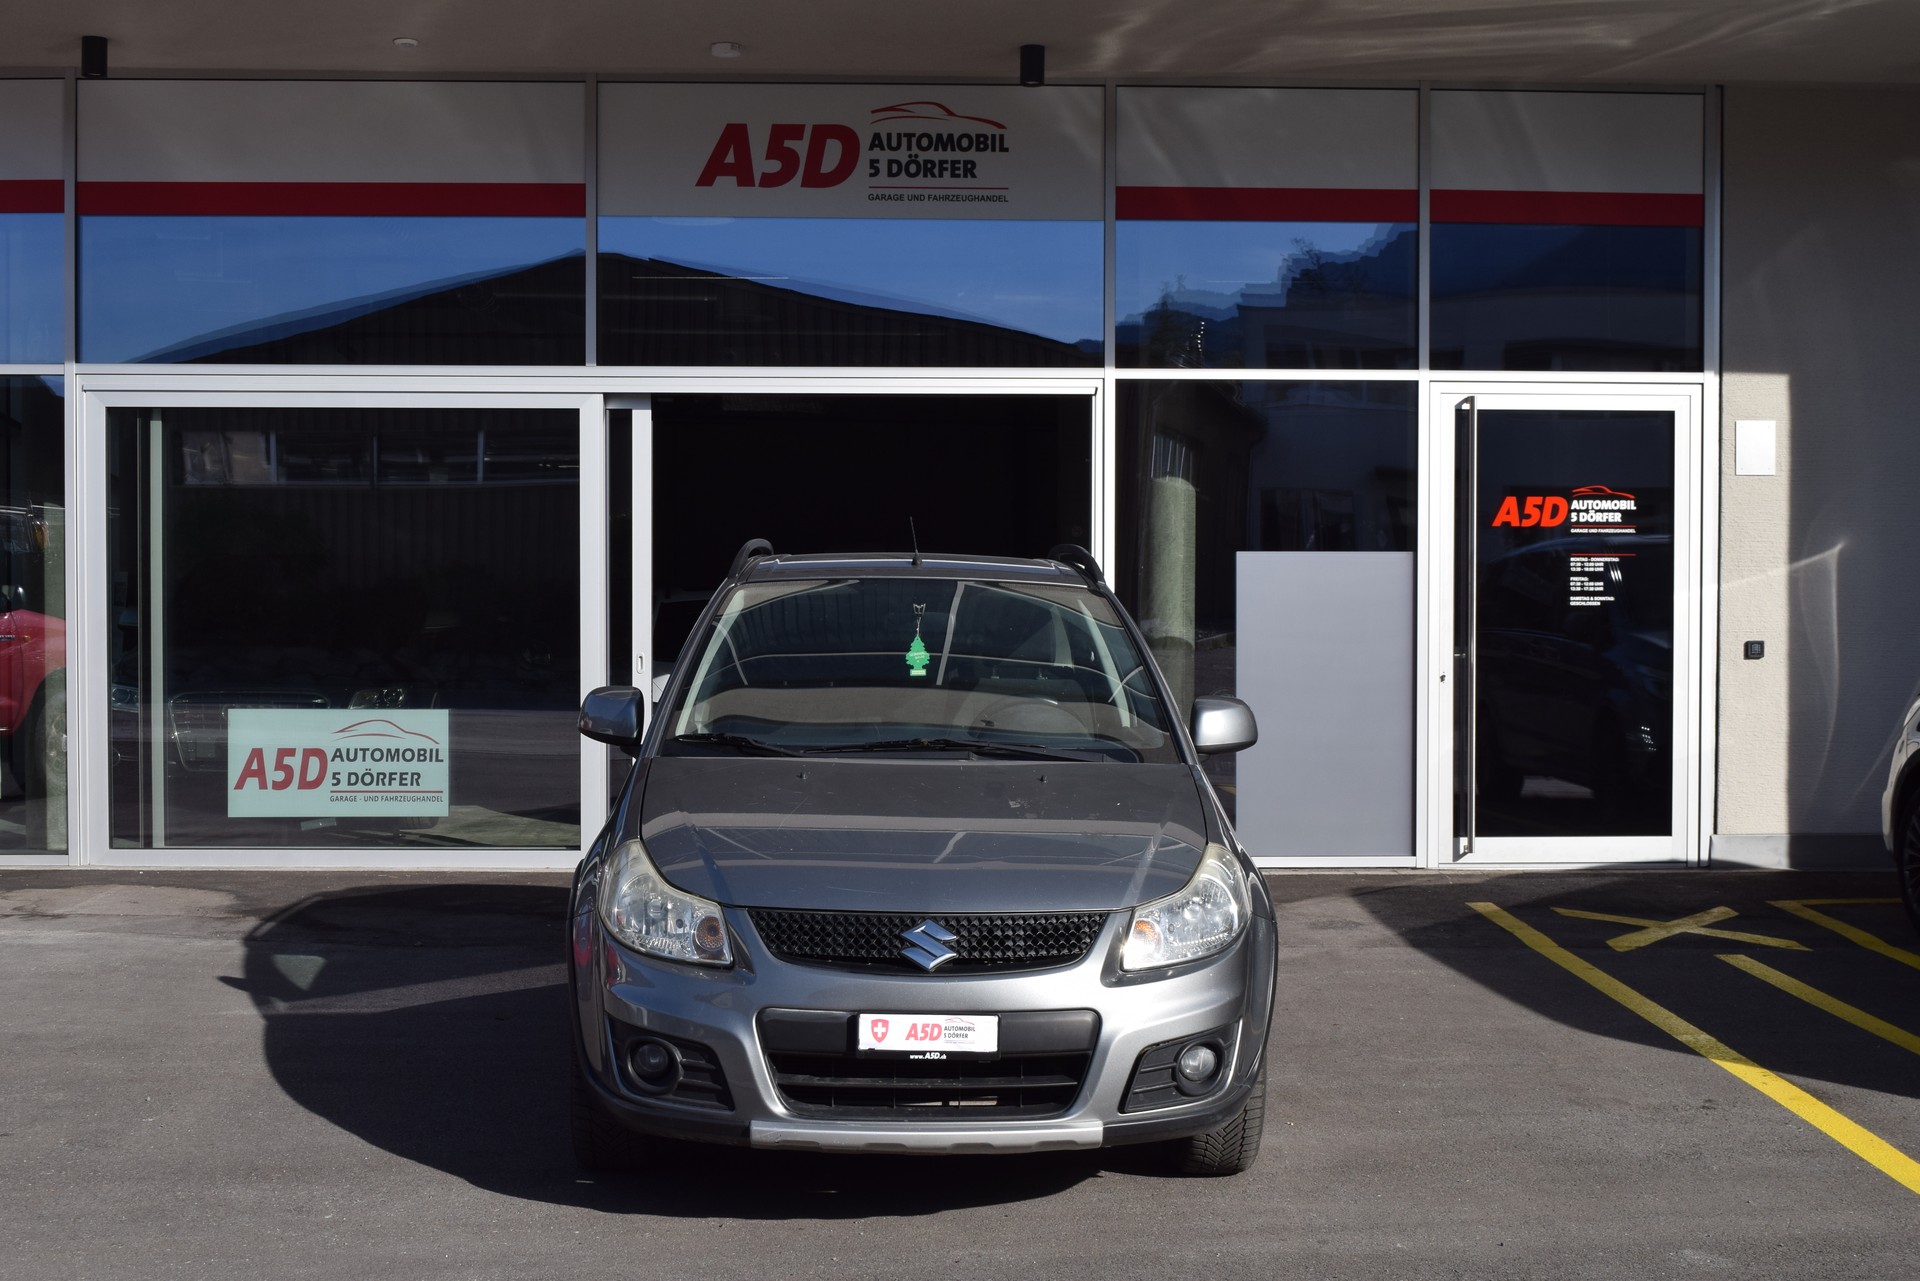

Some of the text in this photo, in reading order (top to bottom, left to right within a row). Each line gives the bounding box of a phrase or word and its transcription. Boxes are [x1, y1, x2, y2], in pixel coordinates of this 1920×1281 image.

[868, 132, 1009, 153] AUTOMOBIL
[695, 123, 860, 188] A5D
[868, 153, 977, 178] 5 DÖRFER
[868, 193, 1009, 202] GARAGE UND FAHRZEUGHANDEL
[1491, 496, 1569, 527] A5D
[1570, 500, 1637, 510] AUTOMOBIL
[1570, 510, 1622, 523] 5 DÖRFER
[330, 748, 444, 763] AUTOMOBIL
[233, 747, 329, 791] A5D
[331, 768, 421, 787] 5 DÖRFER
[905, 1023, 943, 1041] A5D
